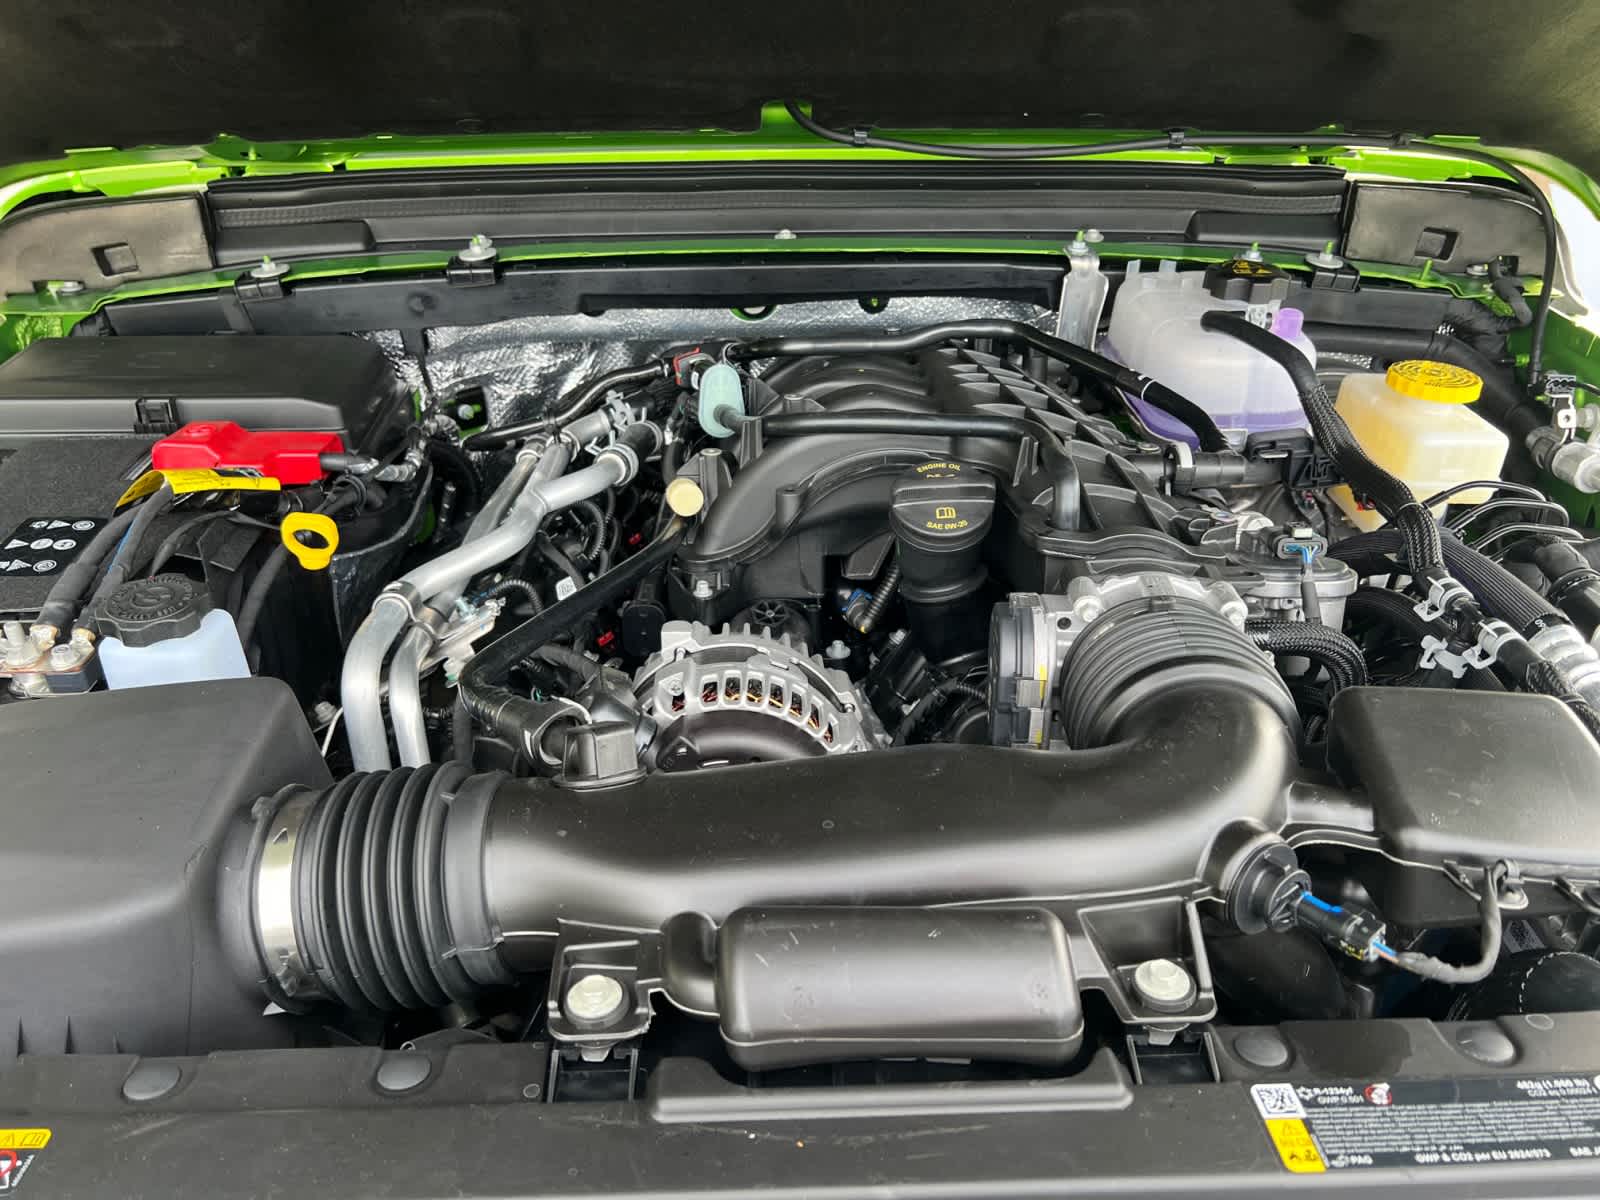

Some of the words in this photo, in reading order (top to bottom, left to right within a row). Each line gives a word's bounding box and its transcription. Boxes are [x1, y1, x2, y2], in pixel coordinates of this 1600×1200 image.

[916, 462, 947, 473] ENGINE
[948, 463, 961, 471] OIL
[926, 521, 943, 530] SAE
[1415, 1152, 1440, 1164] GWP
